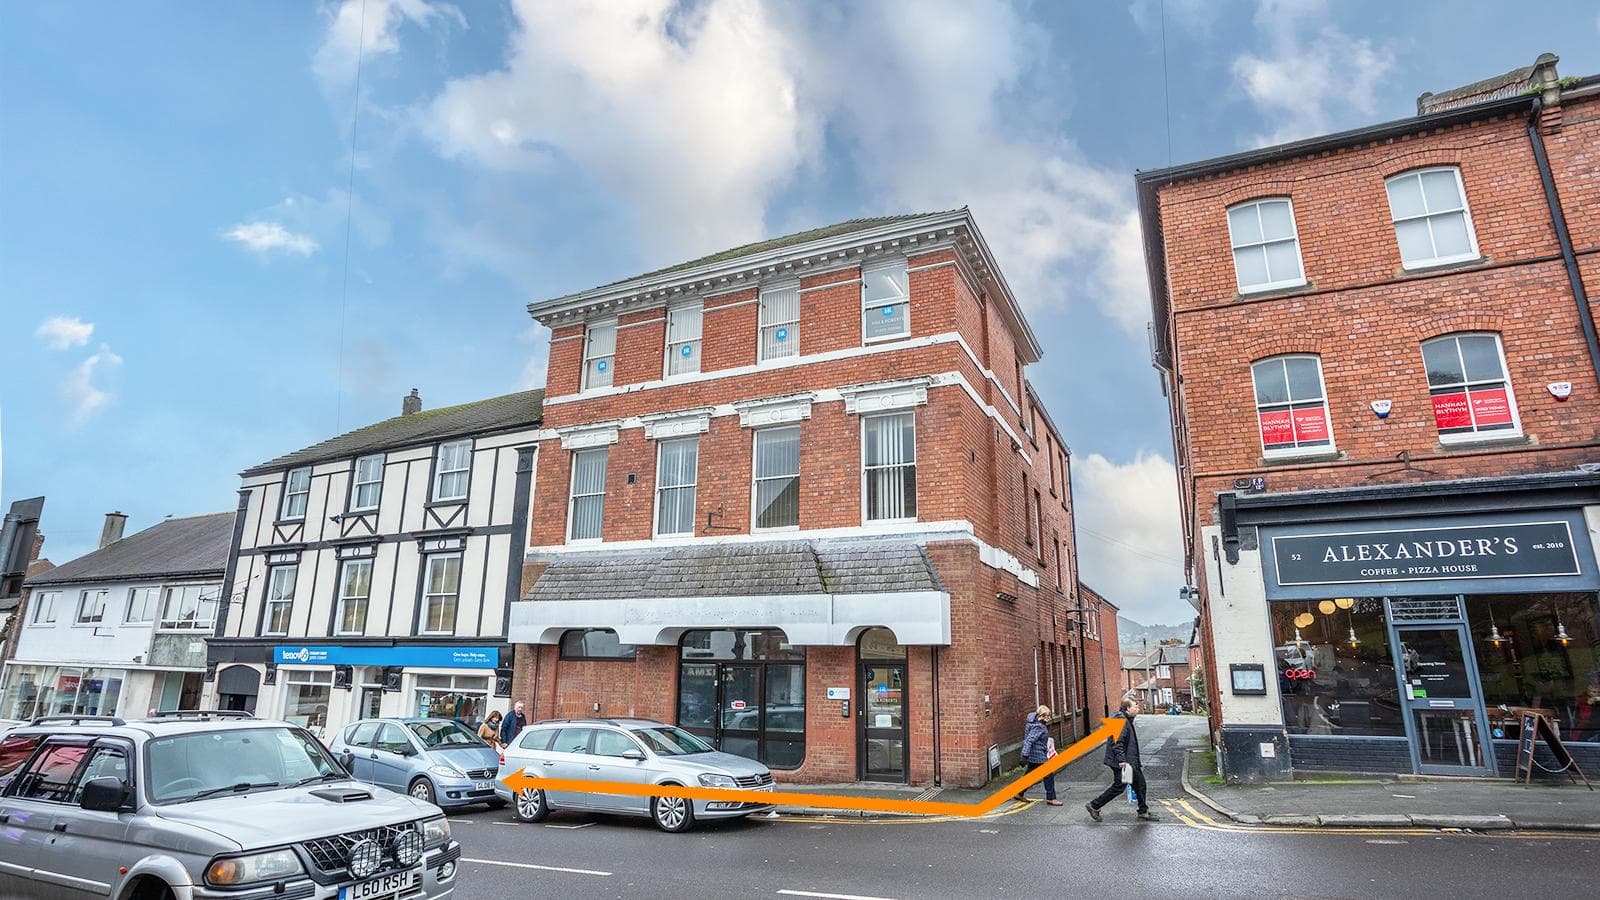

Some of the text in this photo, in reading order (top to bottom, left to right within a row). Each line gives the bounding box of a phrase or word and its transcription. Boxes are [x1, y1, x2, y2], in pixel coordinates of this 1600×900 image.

[1434, 401, 1467, 409] HANNAH
[1322, 537, 1519, 563] ALEXANDER'S
[1546, 541, 1564, 549] 2010
[1360, 564, 1478, 577] COFFEE PIZZA HOUSE
[1285, 669, 1316, 680] open
[353, 871, 408, 899] L60 RSH
